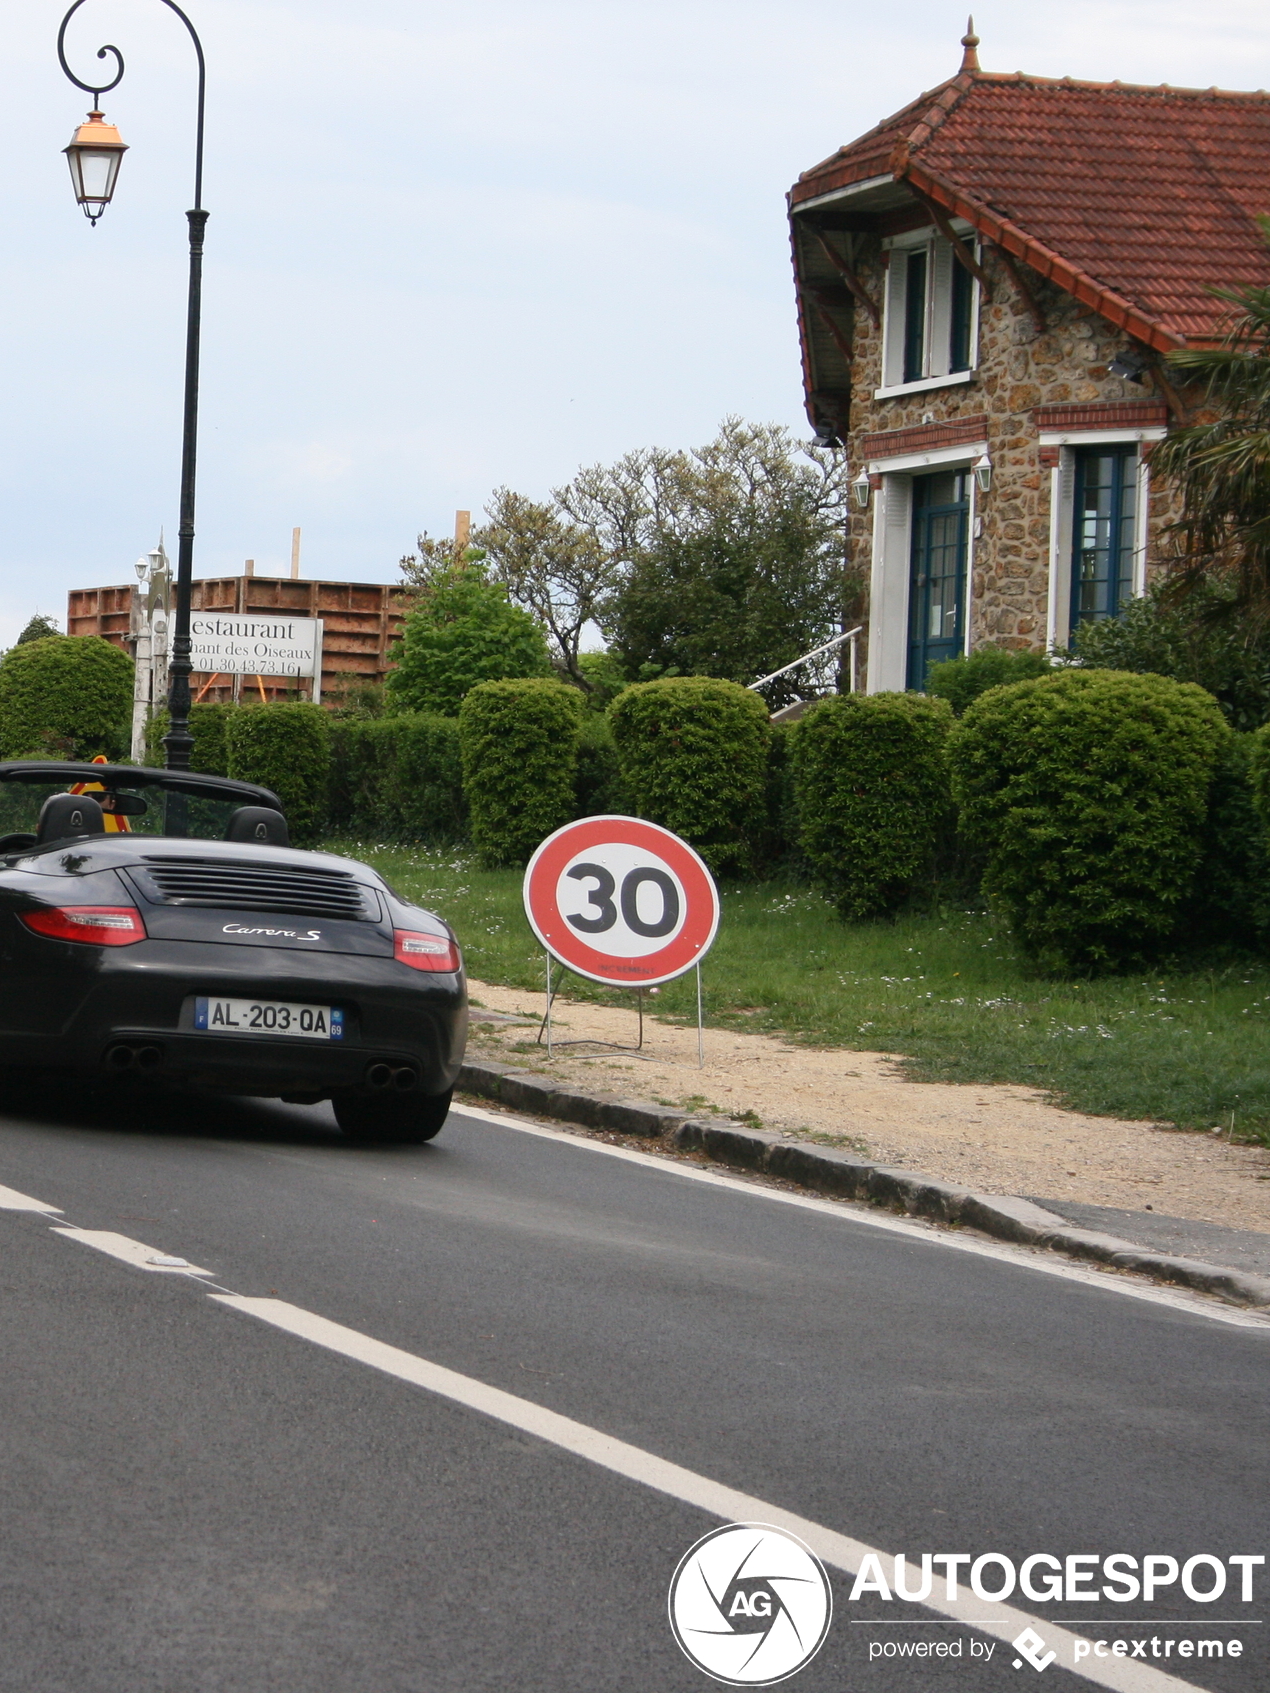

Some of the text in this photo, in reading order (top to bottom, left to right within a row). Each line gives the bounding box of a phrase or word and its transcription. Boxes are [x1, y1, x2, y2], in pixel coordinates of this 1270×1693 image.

[189, 617, 296, 641] estaurant
[225, 641, 249, 657] des
[254, 642, 312, 660] Oiseaux
[199, 657, 296, 675] 01.30.43.73.16
[566, 863, 679, 938] 30
[222, 923, 322, 941] Carrera S
[199, 1015, 205, 1023] F
[211, 1002, 327, 1034] AL-203-QA
[331, 1025, 342, 1036] 69
